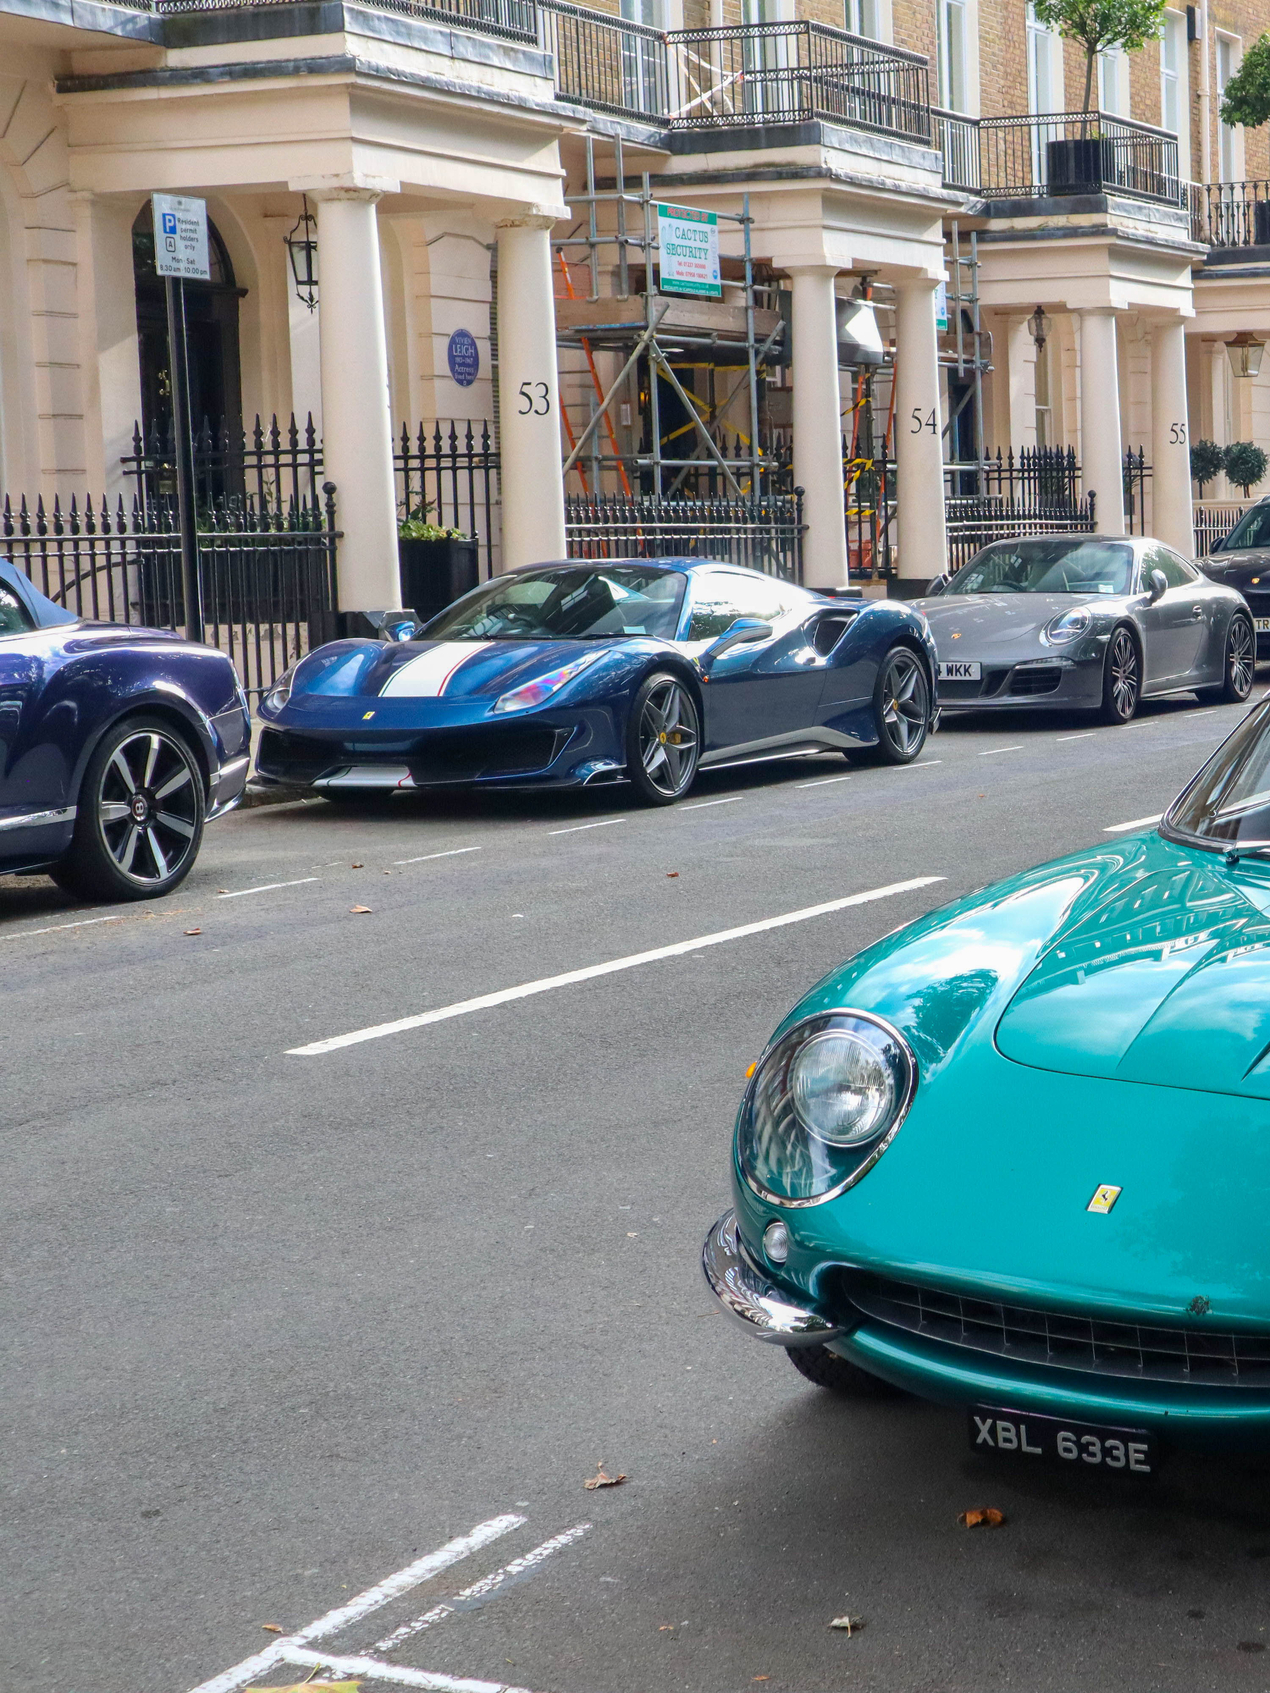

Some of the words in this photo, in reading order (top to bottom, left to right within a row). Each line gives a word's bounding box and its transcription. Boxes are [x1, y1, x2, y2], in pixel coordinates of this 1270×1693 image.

[177, 217, 199, 226] Resident
[667, 207, 700, 221] PROTECTED
[701, 213, 708, 222] BY
[180, 227, 197, 235] permit
[675, 227, 708, 243] CACTUS
[666, 243, 709, 260] SECURITY
[171, 256, 183, 264] Mon
[186, 257, 195, 265] Sat
[452, 344, 475, 357] LEIGH
[454, 364, 475, 373] Actress
[518, 382, 550, 415] 53
[911, 408, 937, 435] 54
[1169, 423, 1186, 444] 55
[946, 664, 972, 677] WKK
[973, 1416, 1042, 1455] XBL
[1056, 1431, 1151, 1473] 633E
